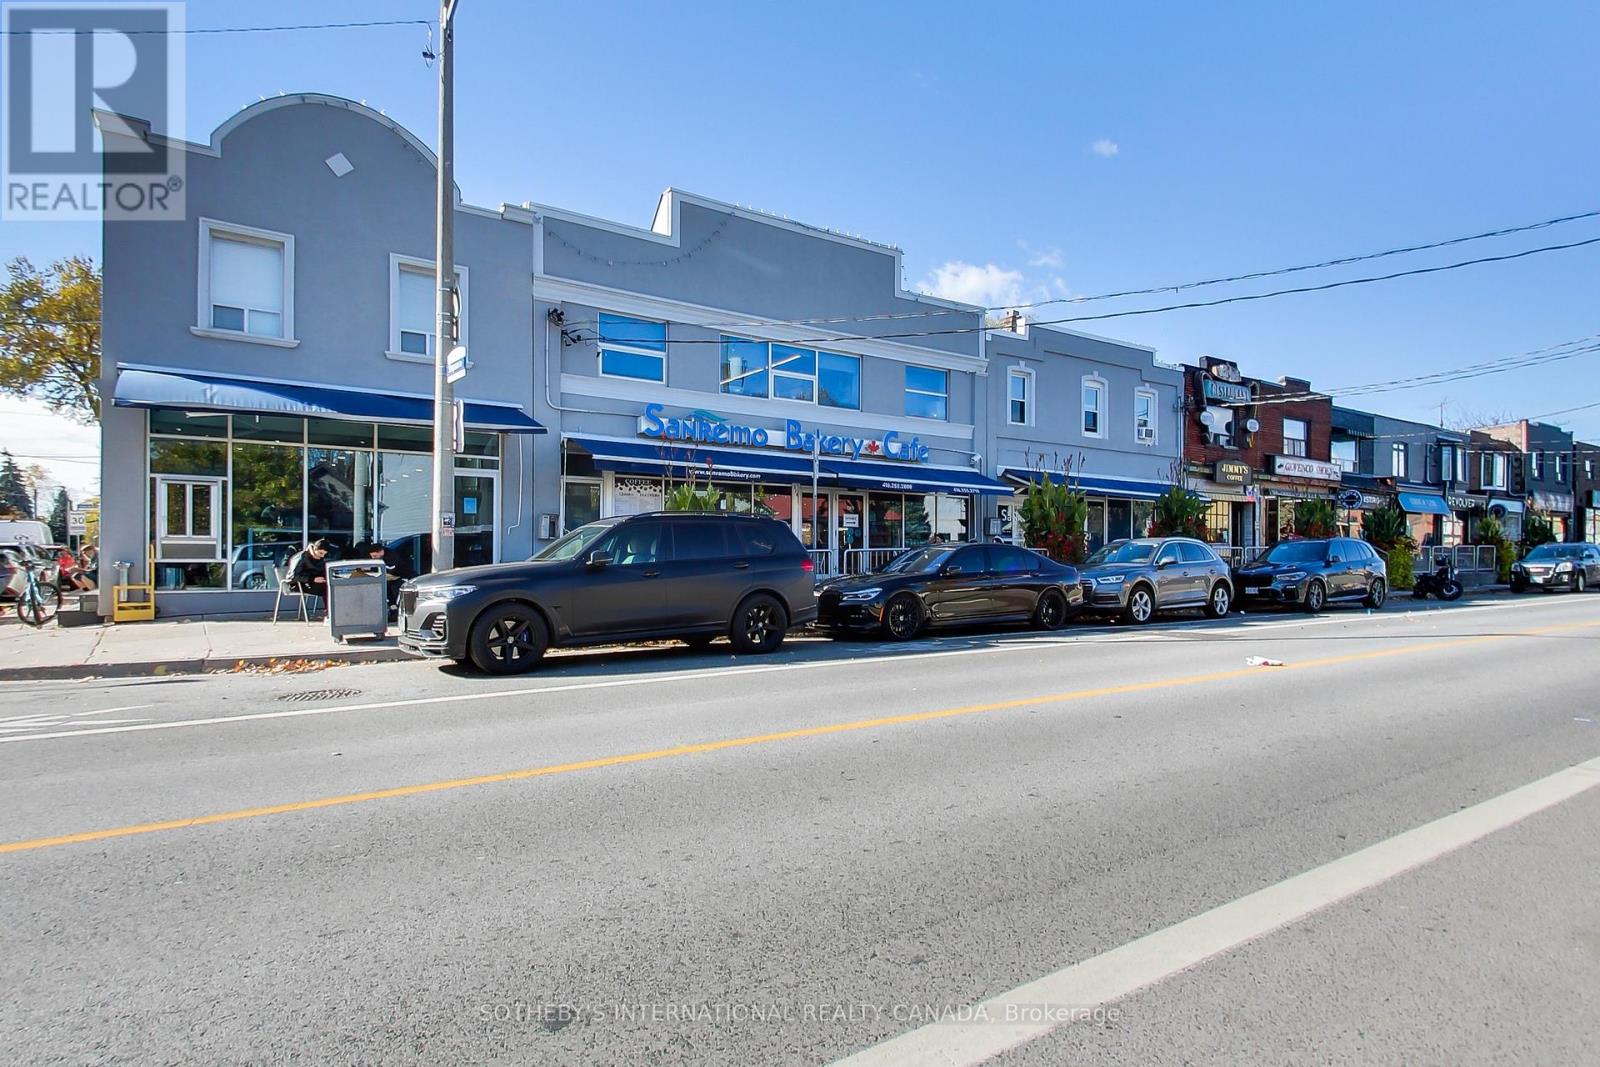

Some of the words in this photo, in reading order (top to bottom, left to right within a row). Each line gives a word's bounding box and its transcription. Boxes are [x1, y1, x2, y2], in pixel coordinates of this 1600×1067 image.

[786, 419, 864, 460] Bakery
[883, 430, 929, 463] Cafe
[1221, 463, 1249, 475] JIMMY'S
[71, 516, 85, 525] 30
